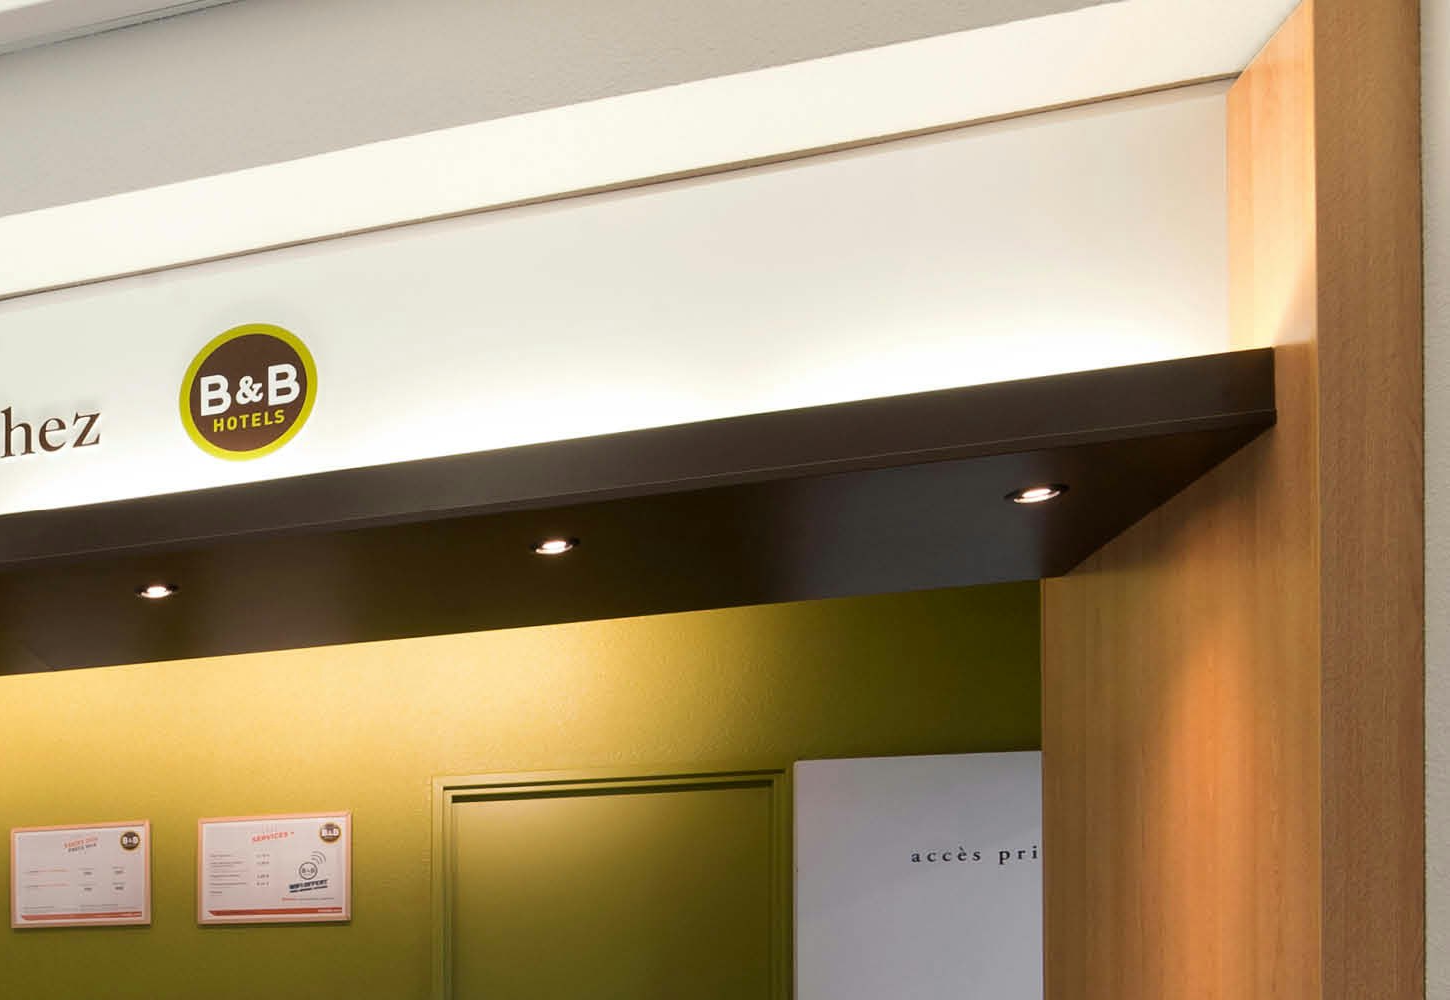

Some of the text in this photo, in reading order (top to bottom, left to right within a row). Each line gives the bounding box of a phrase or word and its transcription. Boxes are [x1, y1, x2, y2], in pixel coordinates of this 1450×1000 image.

[200, 363, 300, 416] B&B
[213, 409, 285, 432] HOTELS
[910, 846, 982, 863] accès
